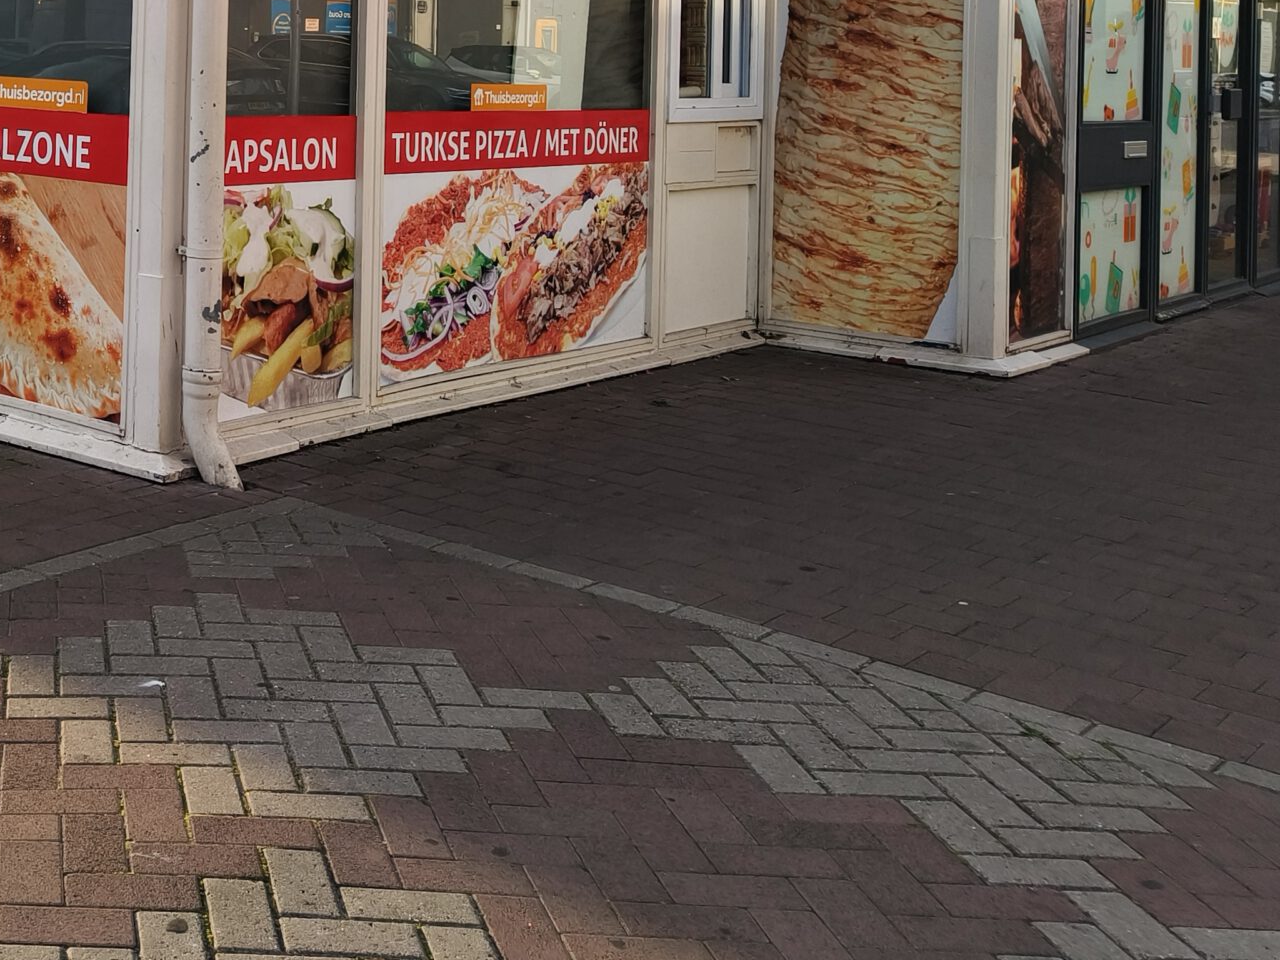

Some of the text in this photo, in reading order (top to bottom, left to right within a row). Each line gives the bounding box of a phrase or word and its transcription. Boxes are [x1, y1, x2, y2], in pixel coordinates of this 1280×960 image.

[484, 90, 546, 108] Thuisbezorgd.nl
[224, 137, 337, 174] APSALON
[391, 121, 639, 163] TURKSE PIZZA / MET DÖNER
